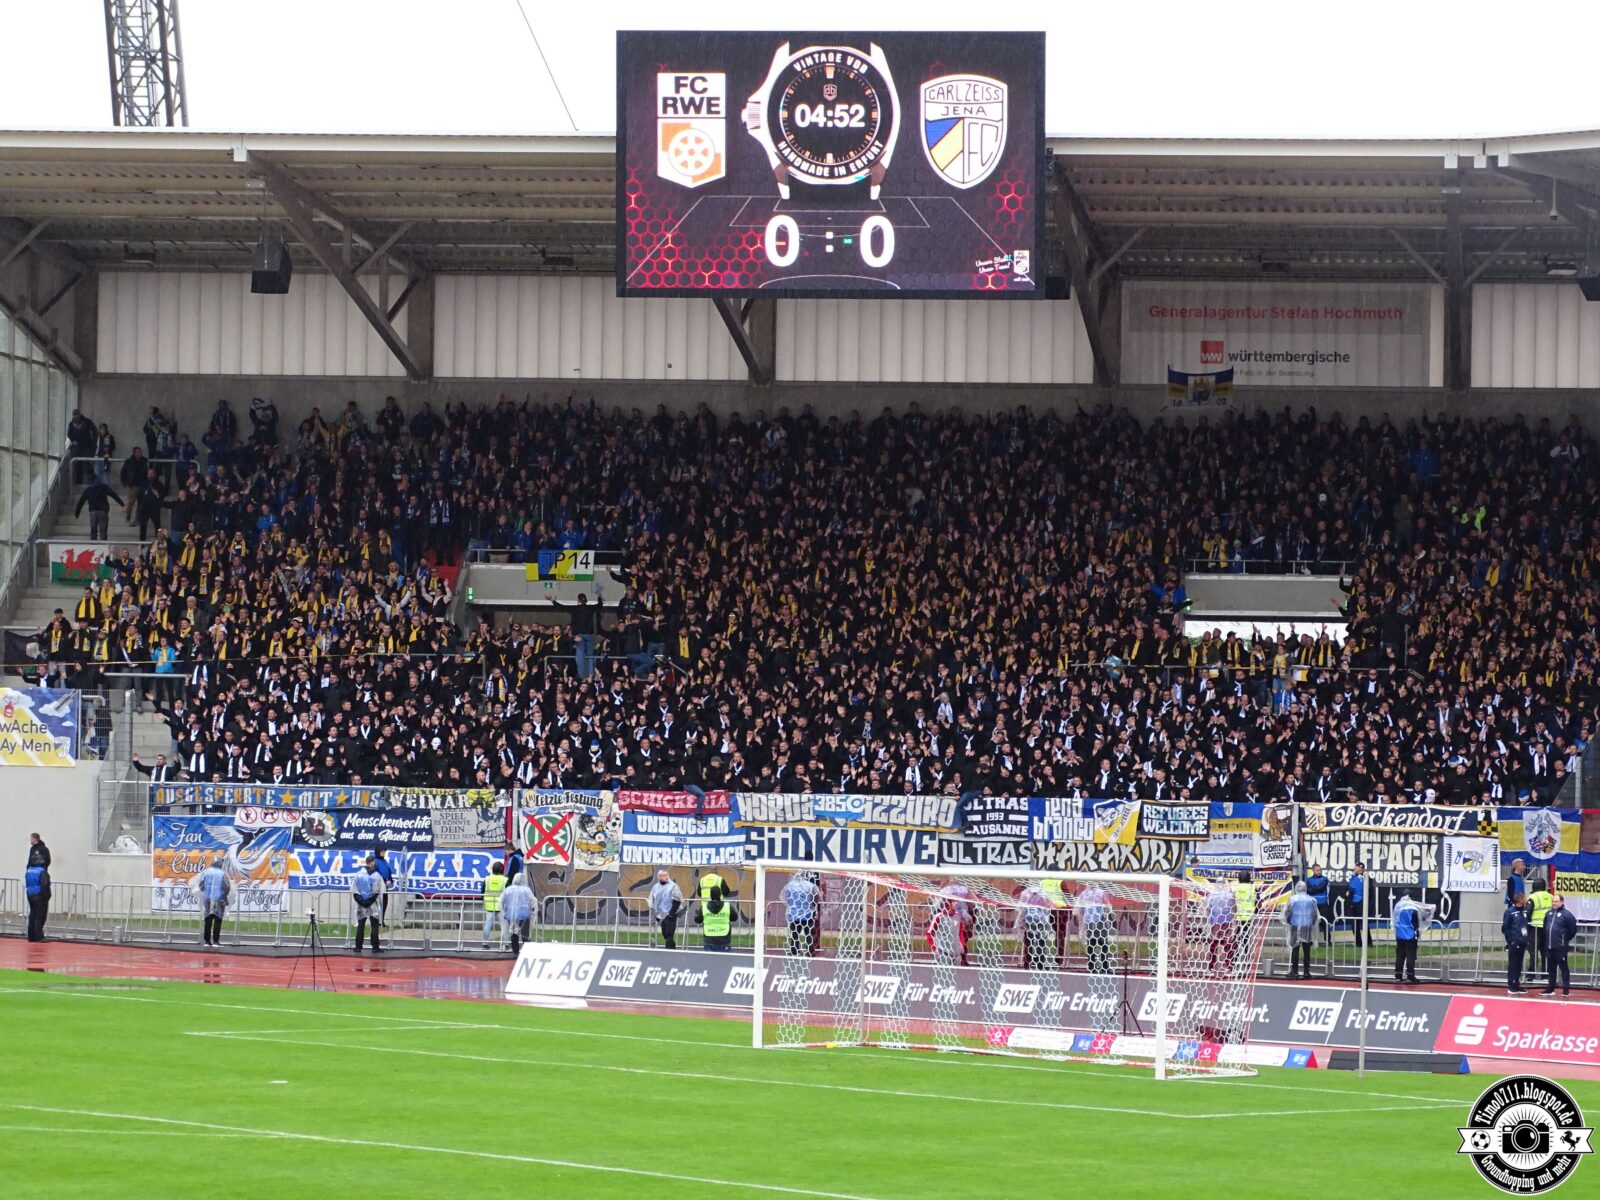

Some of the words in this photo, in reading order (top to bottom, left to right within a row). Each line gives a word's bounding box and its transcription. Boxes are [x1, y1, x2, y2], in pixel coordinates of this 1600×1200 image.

[793, 53, 843, 71] VINTAGE
[674, 76, 708, 94] FC
[928, 84, 960, 101] CARL
[965, 84, 1000, 101] ZEISS
[662, 96, 721, 115] RWE
[795, 104, 865, 127] 04:52
[941, 106, 987, 116] JENA
[778, 141, 829, 176] HANDMADE
[834, 166, 847, 176] IN
[849, 140, 883, 172] ERFURT
[765, 215, 799, 267] 0
[860, 215, 894, 267] 0
[1149, 305, 1267, 321] Generalagentur
[1271, 305, 1318, 319] Stefan
[1324, 306, 1403, 320] Hochmuth
[1229, 349, 1350, 365] württembergische
[22, 739, 51, 752] Men
[156, 787, 275, 805] AUSGESPERRTE
[299, 791, 332, 807] MIT
[352, 791, 380, 807] UNS
[389, 794, 470, 808] WEIMAR
[343, 813, 431, 829] Menschenrechte
[1144, 805, 1208, 820] REFUGEES
[1331, 805, 1466, 834] Rockendorf
[441, 826, 465, 834] DEIN
[637, 814, 729, 835] UNBEUGSAM
[1144, 820, 1207, 834] WELCOME
[169, 823, 203, 847] Fan
[340, 832, 354, 840] aus
[357, 830, 375, 840] dem
[411, 832, 432, 841] holen
[623, 845, 745, 865] UNVERKÄUFLICH
[745, 827, 936, 865] SÜDKURVE
[942, 841, 1031, 864] ULTRAS
[297, 850, 490, 878] WEMAR
[1304, 842, 1438, 871] WOLFPACK
[1346, 870, 1419, 884] SPORTERS
[1450, 880, 1495, 889] CHAOTEN
[605, 964, 636, 982] SWE
[642, 967, 667, 985] Für
[666, 967, 708, 988] Erfurt.
[731, 972, 754, 989] SW
[770, 975, 793, 992] Für
[793, 976, 839, 996] Erfurt.
[863, 980, 894, 999] SWE
[903, 983, 930, 1001] Für
[928, 984, 975, 1005] Erfurt.
[1000, 989, 1033, 1008] SWE
[1042, 991, 1070, 1010] Für
[1190, 1000, 1218, 1019] Für
[1297, 1007, 1333, 1025] SWE
[1346, 1009, 1375, 1028] Für
[1374, 1011, 1430, 1033] Erfurt.
[1492, 1026, 1599, 1053] Sparkasse
